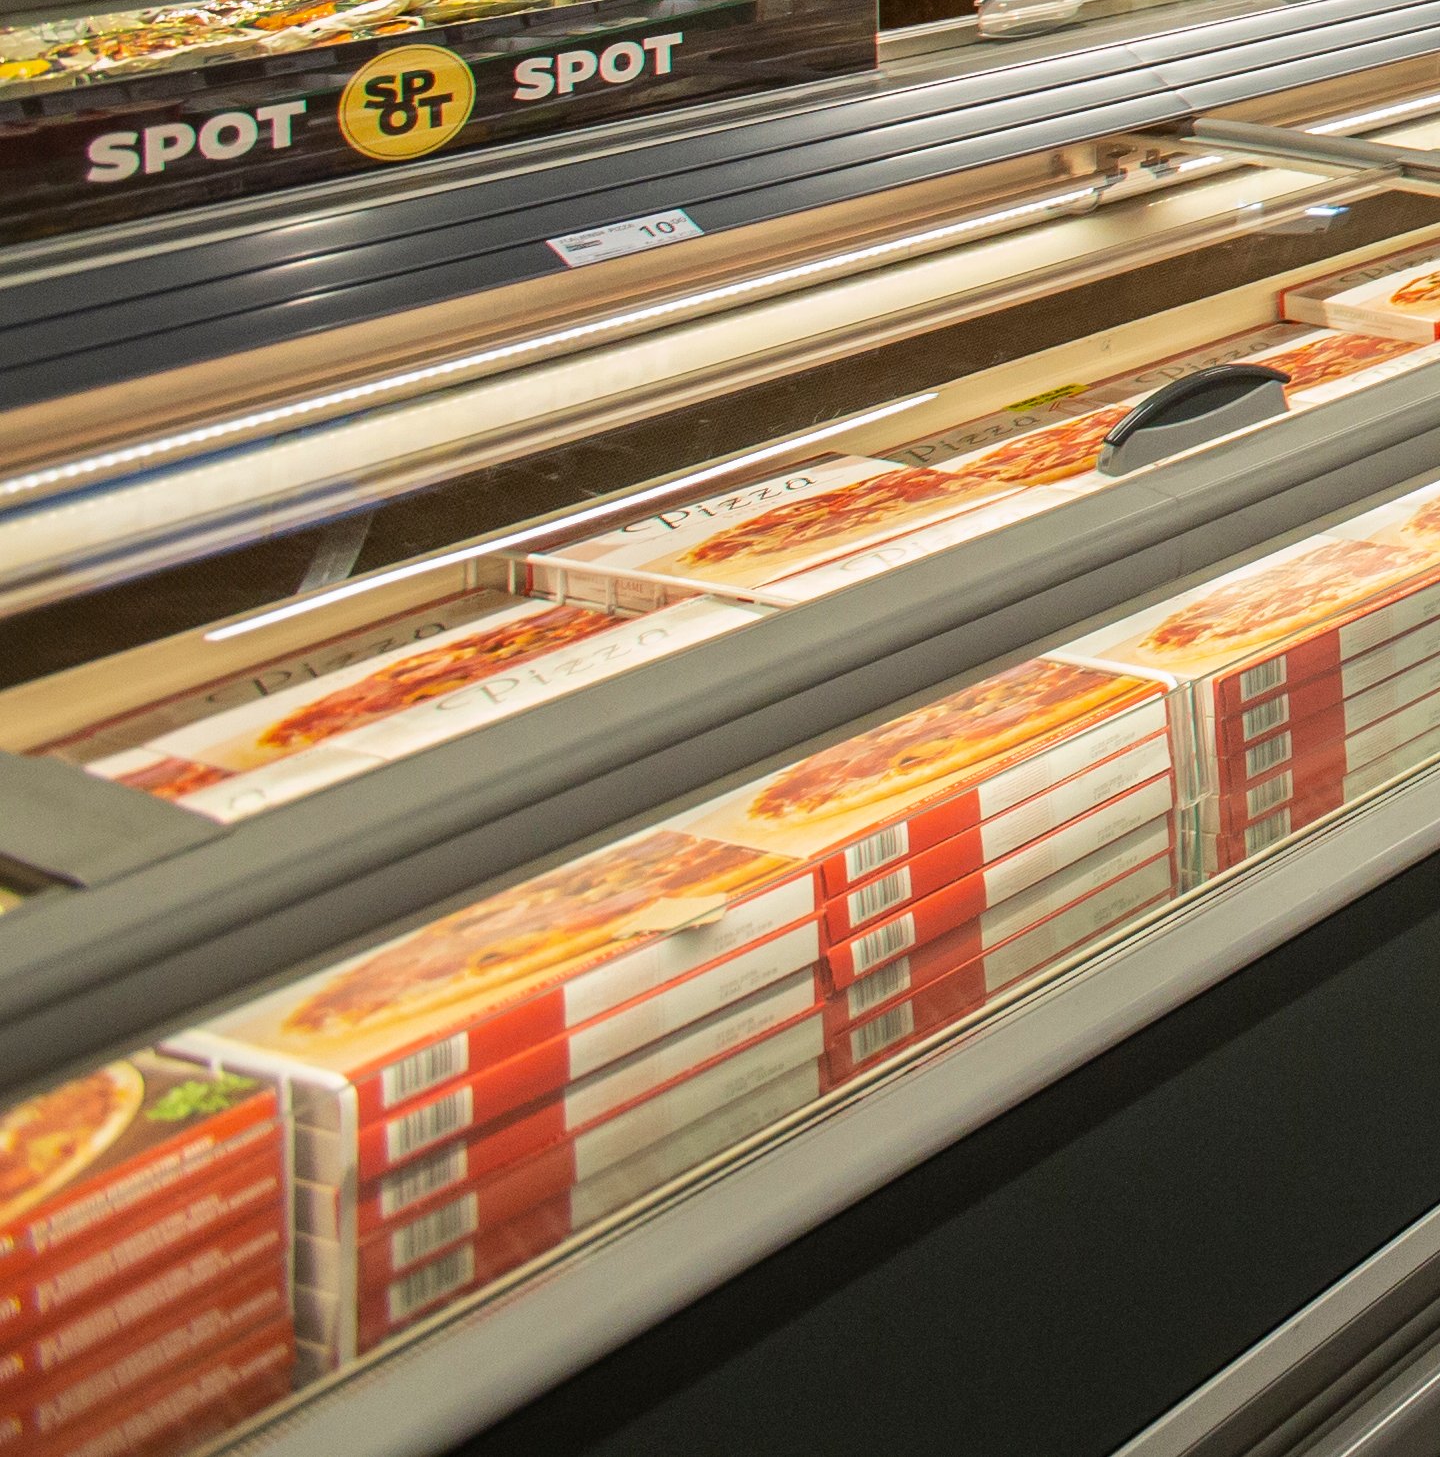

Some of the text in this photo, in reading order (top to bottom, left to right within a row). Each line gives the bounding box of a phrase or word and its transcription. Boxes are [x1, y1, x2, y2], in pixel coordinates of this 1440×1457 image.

[513, 31, 684, 102] SPOT
[86, 100, 307, 184] SPOT
[639, 220, 676, 238] 10
[620, 472, 820, 535] Pizza
